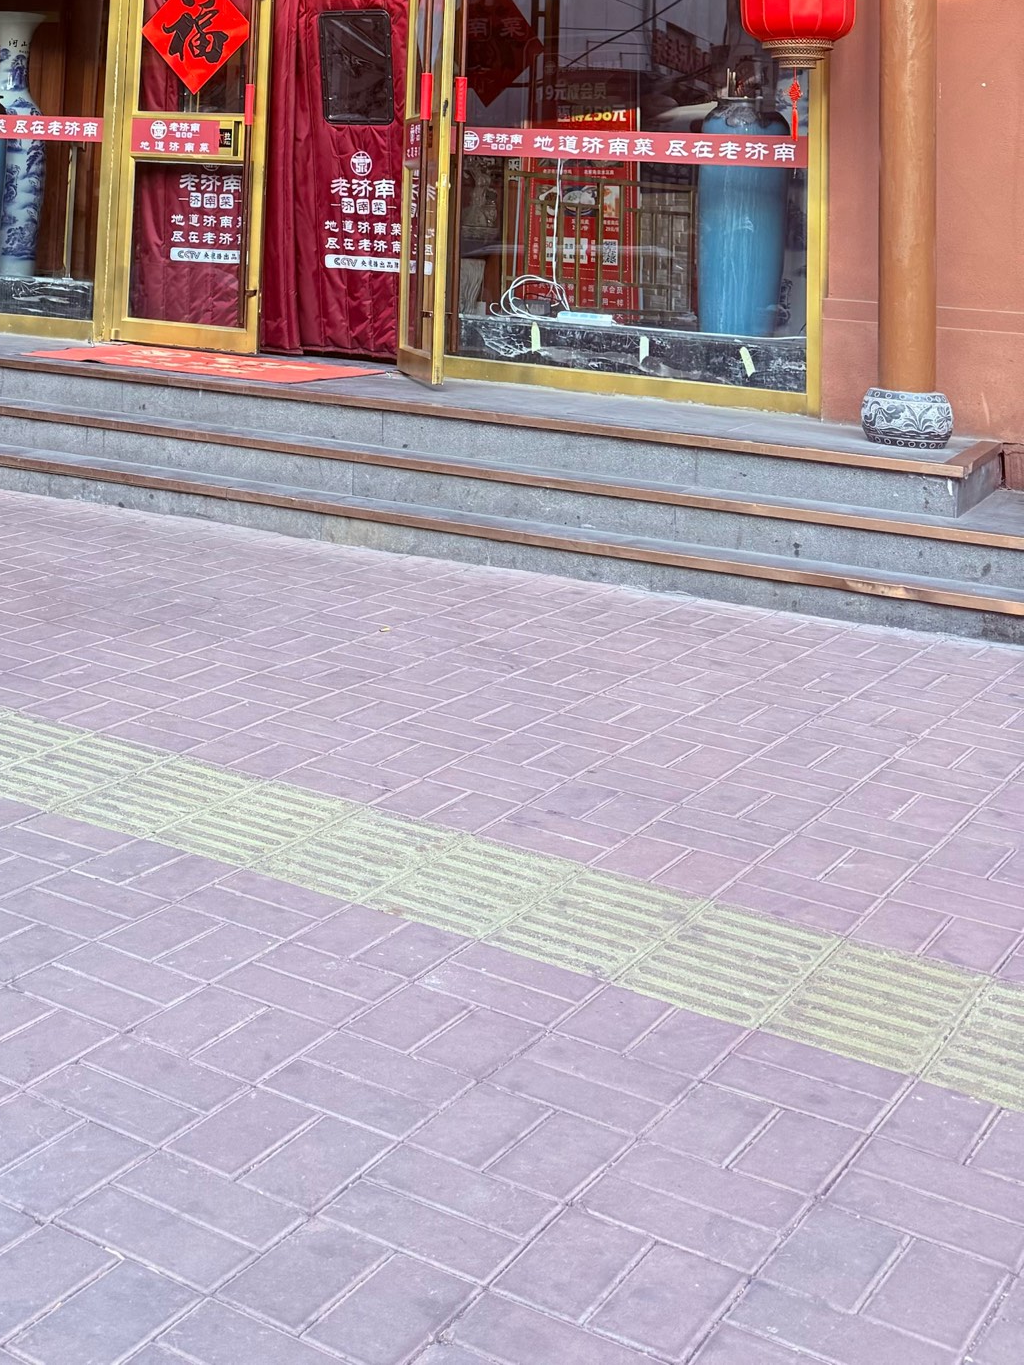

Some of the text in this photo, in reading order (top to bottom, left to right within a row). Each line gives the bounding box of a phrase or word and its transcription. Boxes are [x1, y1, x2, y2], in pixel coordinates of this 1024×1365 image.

[13, 120, 99, 138] 尽在老济南
[139, 141, 210, 153] 地道济南菜
[482, 133, 797, 163] 老济南 地道济南菜 尽在老济南
[330, 177, 396, 199] 老济南
